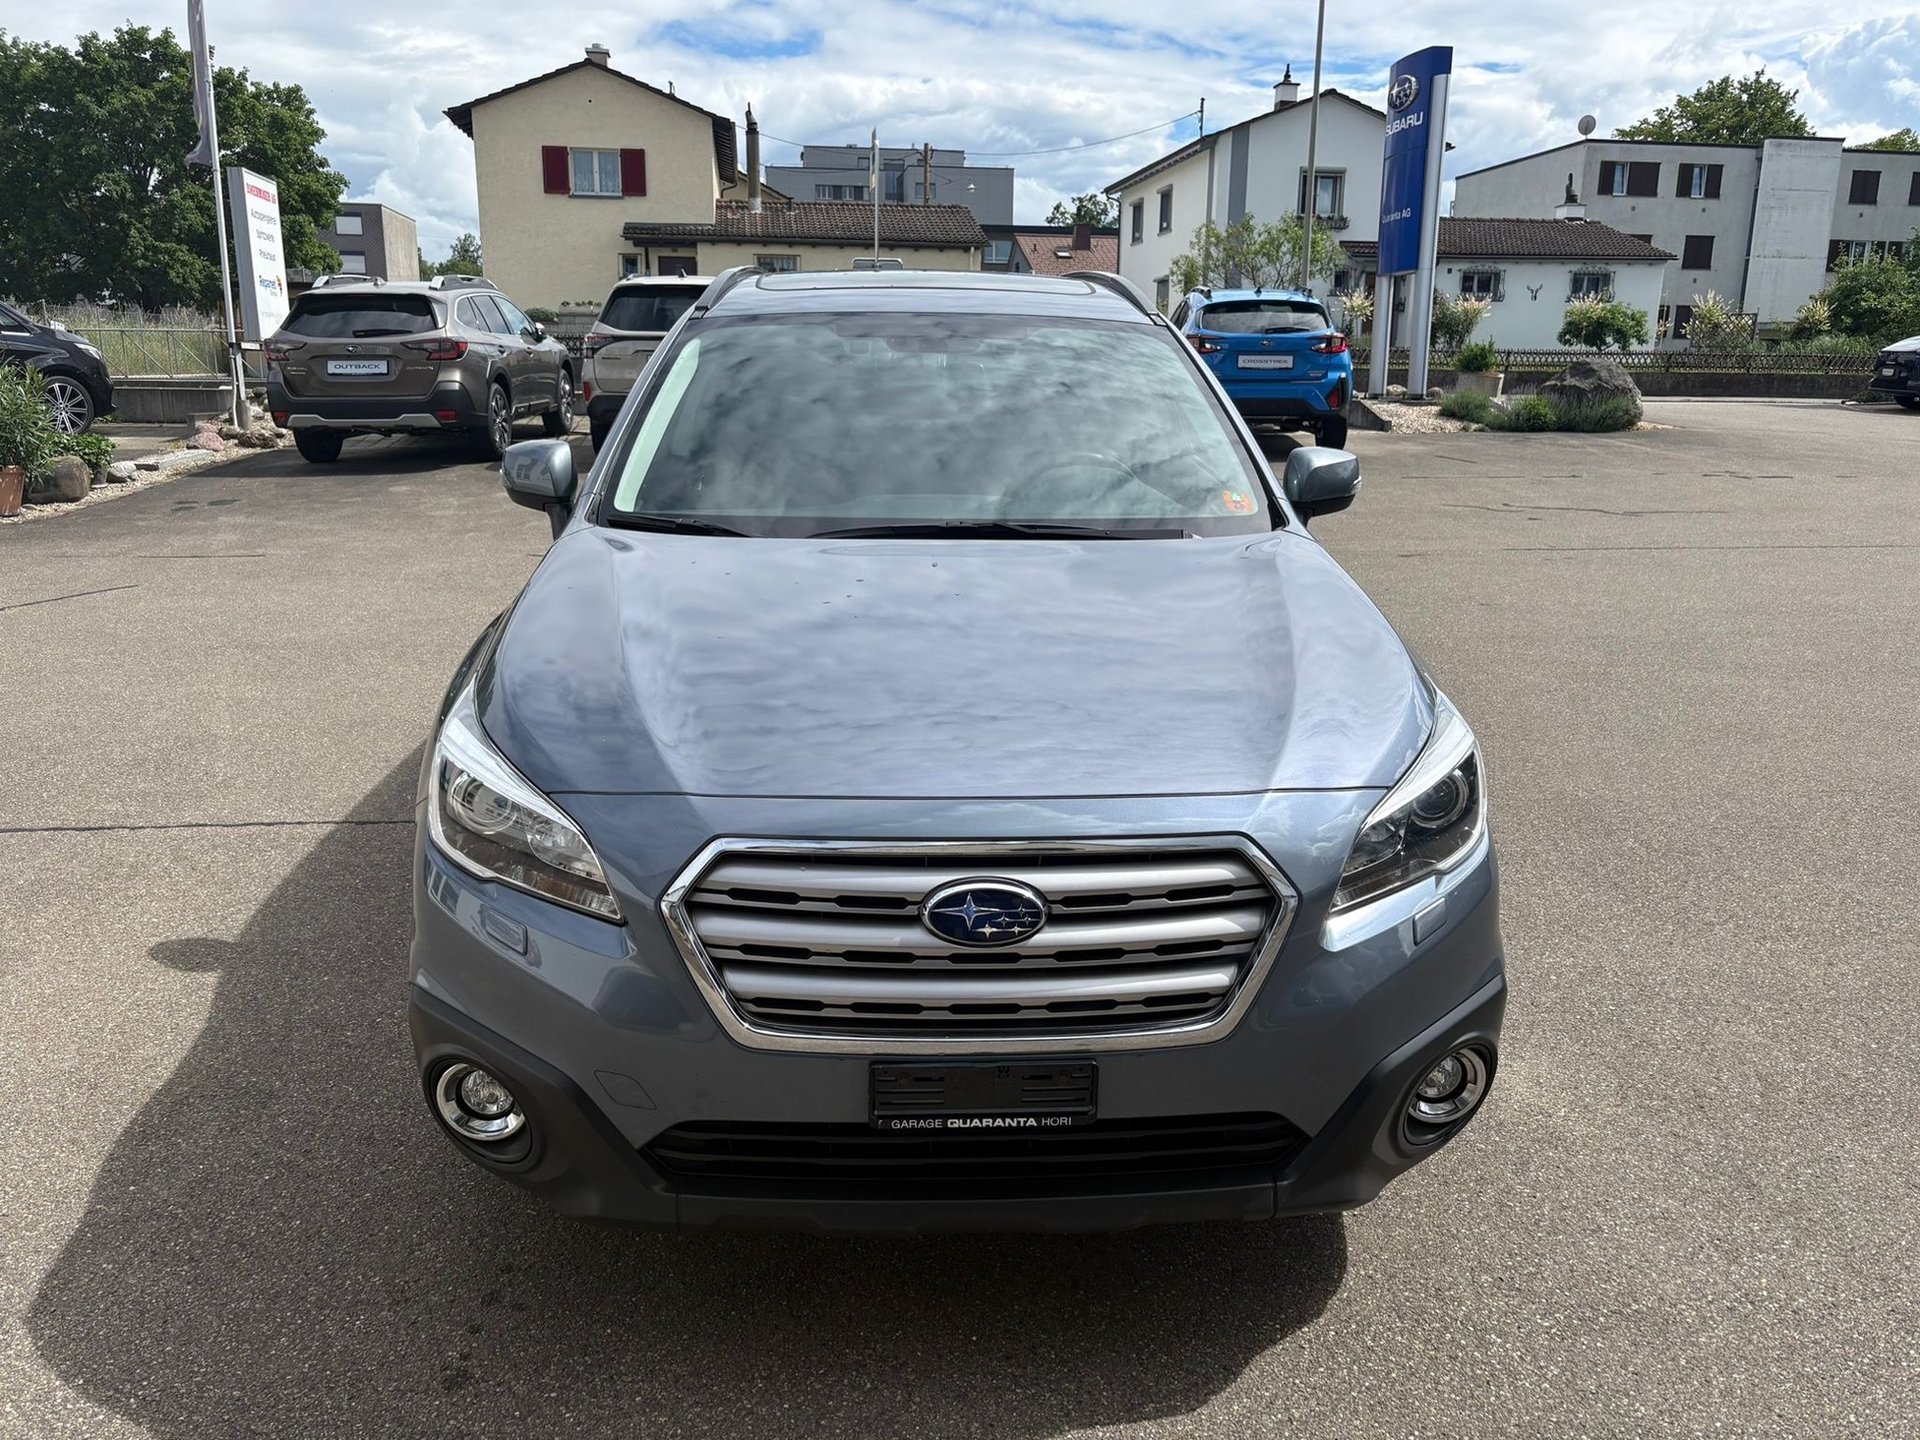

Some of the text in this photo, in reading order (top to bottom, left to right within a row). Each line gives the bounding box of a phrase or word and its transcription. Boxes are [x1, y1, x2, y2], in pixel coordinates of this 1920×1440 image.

[1385, 111, 1423, 137] SUBARU
[1401, 207, 1411, 219] AG
[891, 1118, 943, 1129] GARAGE
[947, 1116, 1038, 1128] QUARANTA
